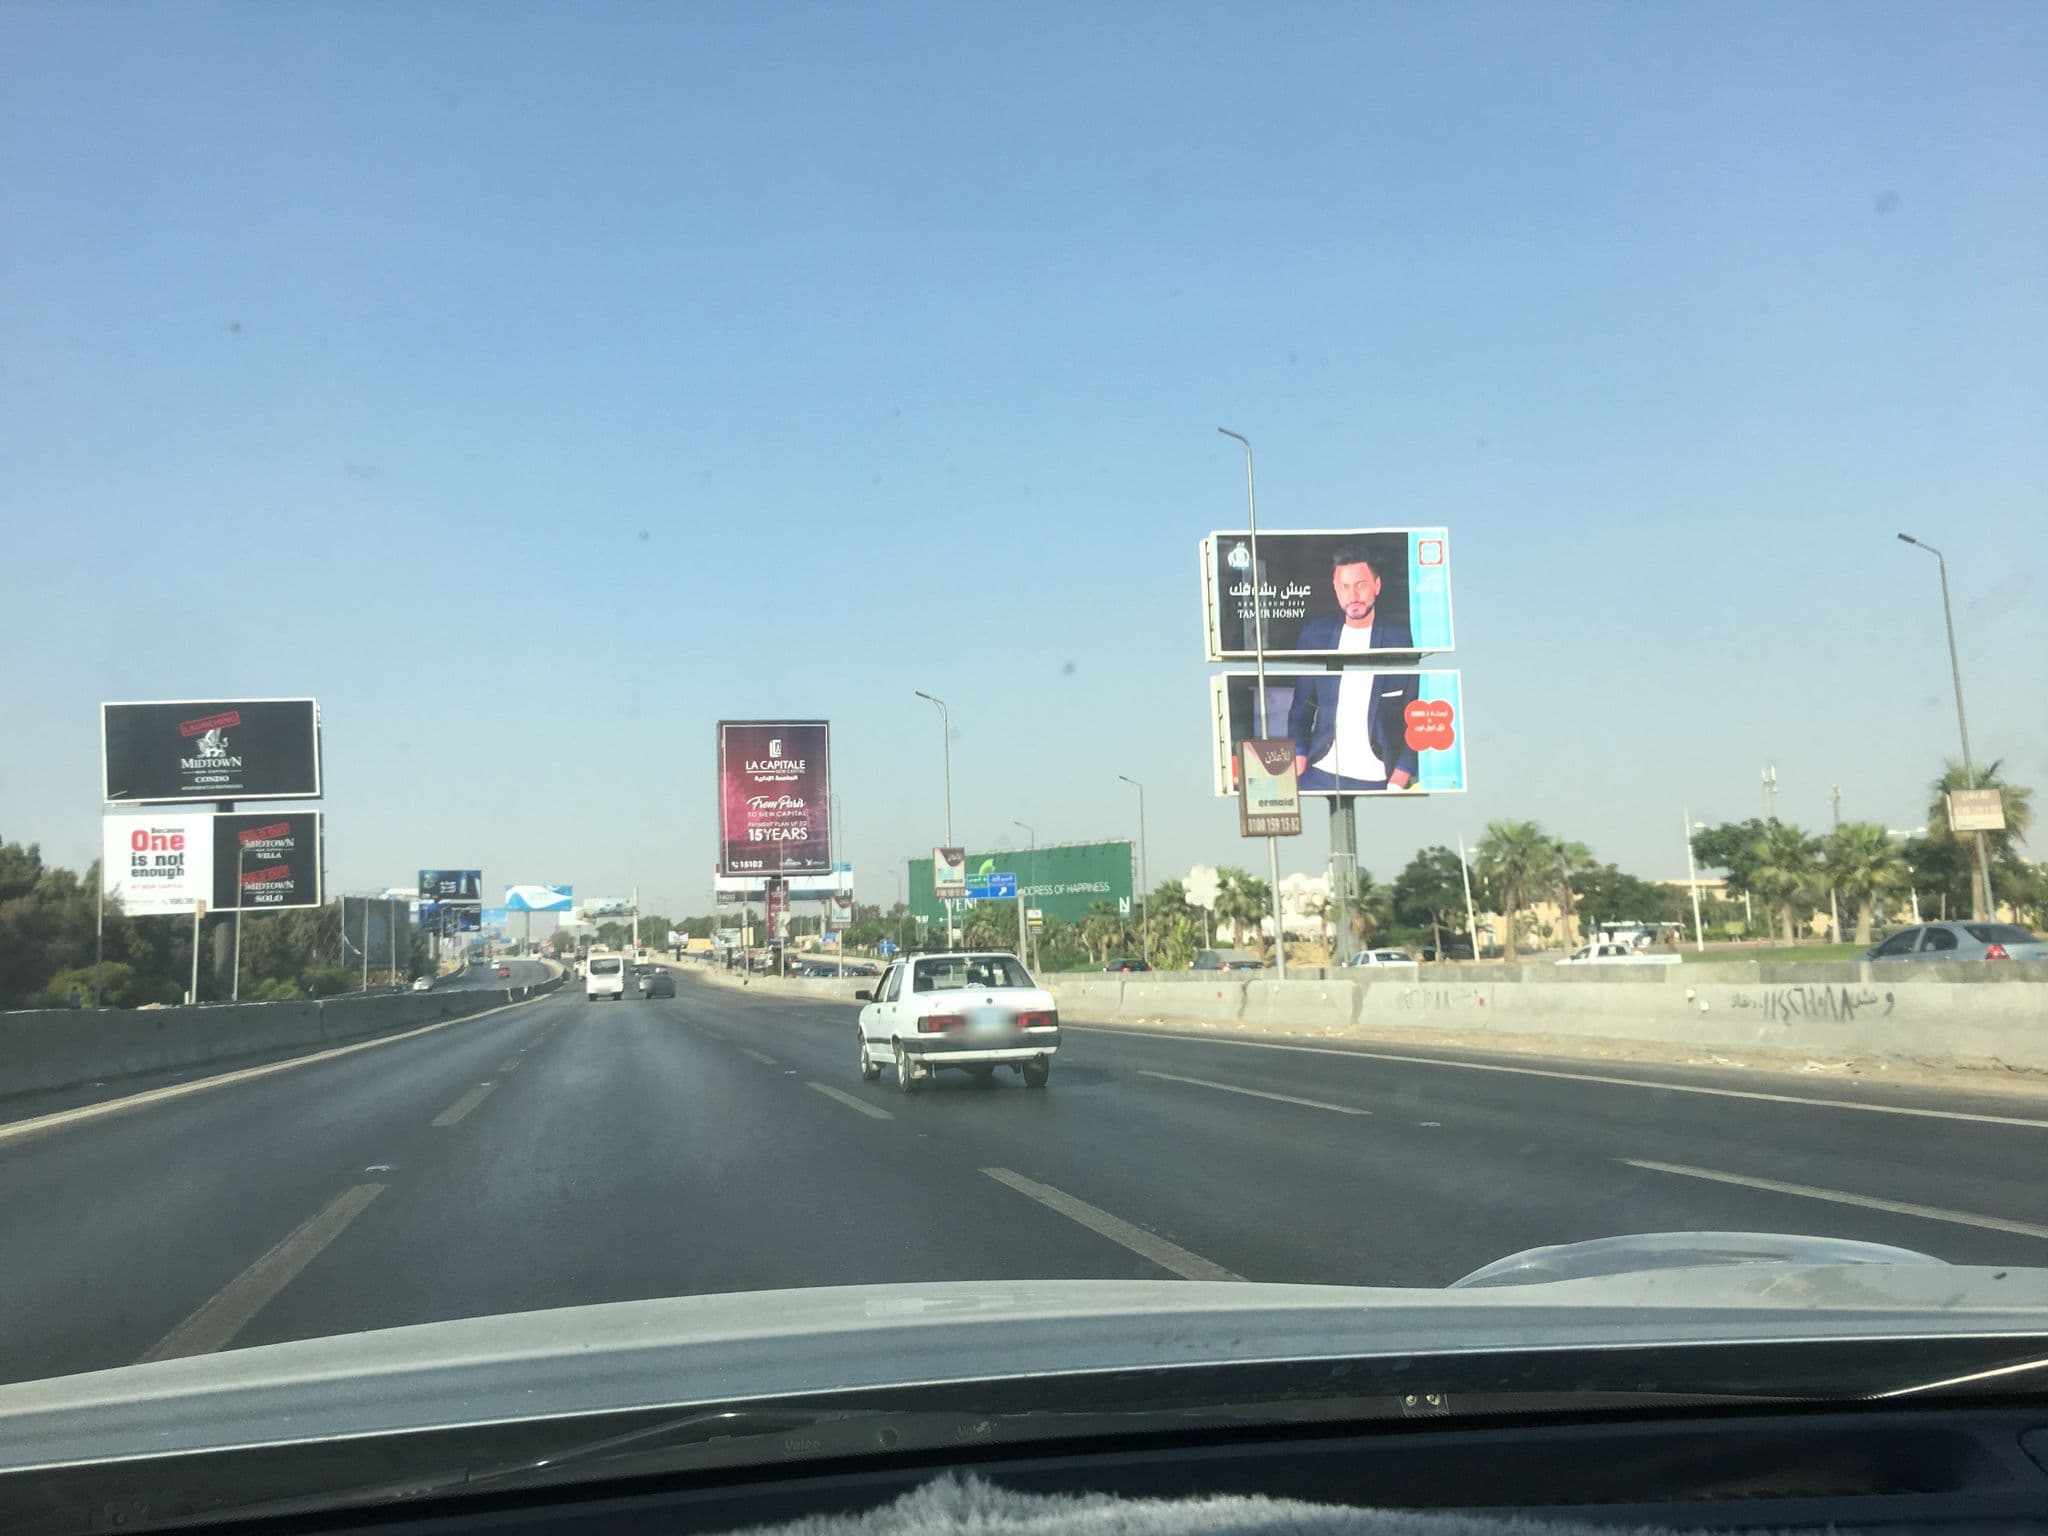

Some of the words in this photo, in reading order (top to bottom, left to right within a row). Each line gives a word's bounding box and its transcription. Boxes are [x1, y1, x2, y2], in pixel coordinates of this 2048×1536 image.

[1272, 607, 1306, 619] HOSNY
[180, 756, 242, 769] MIDTOWN
[745, 760, 759, 770] LA
[760, 759, 806, 770] CAPITALE
[194, 775, 230, 783] CONDO
[746, 795, 778, 810] From
[778, 795, 806, 810] Paris
[130, 829, 185, 852] One
[244, 837, 295, 850] MIDTOWN
[131, 852, 148, 867] is
[155, 851, 185, 867] not
[130, 865, 185, 880] enough
[244, 879, 295, 891] MIDTOWN
[1066, 881, 1111, 894] HAPPINESS
